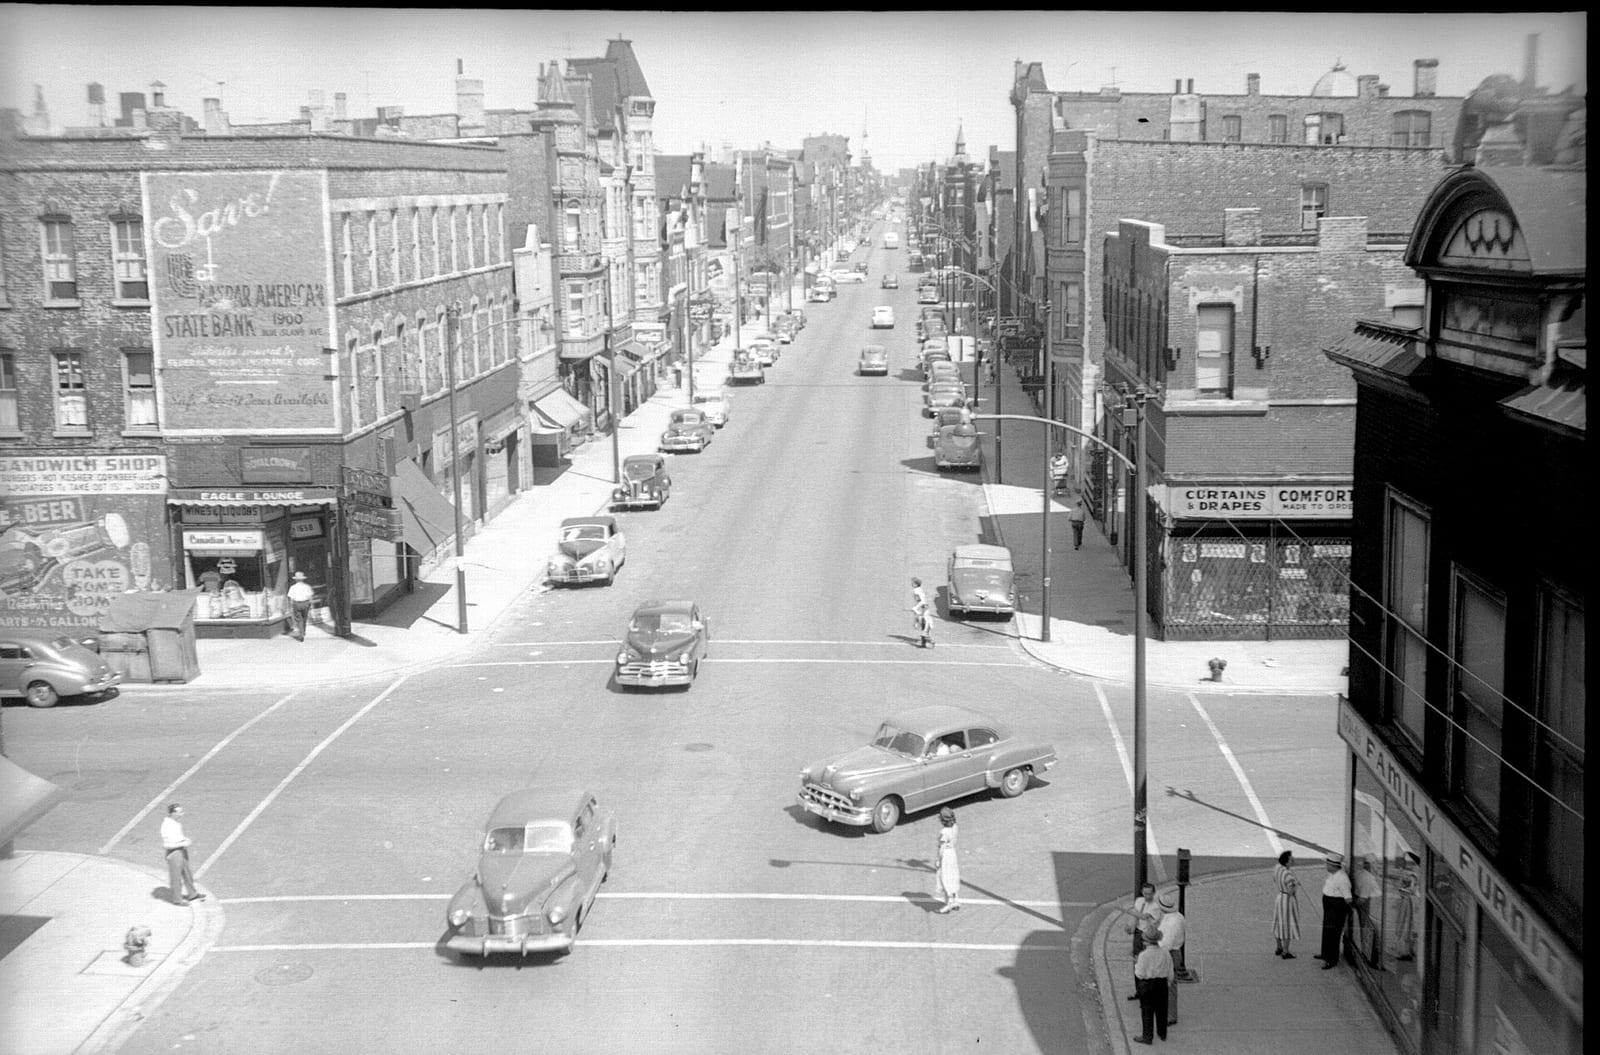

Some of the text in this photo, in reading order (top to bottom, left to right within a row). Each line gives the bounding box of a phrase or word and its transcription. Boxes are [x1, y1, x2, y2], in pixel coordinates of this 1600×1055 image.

[256, 283, 325, 308] AMERICAN
[272, 312, 304, 325] 1900
[164, 313, 256, 338] STATE BANK
[0, 458, 159, 472] SANDWICH SHOP
[200, 491, 305, 500] EAGLE LOUNGE
[1185, 490, 1267, 500] CURTAINS
[24, 500, 77, 523] BEER
[222, 504, 258, 518] LIQUORS
[1199, 501, 1262, 511] DRAPES
[189, 535, 226, 545] Canadian
[71, 567, 121, 579] TAKE
[73, 581, 122, 593] SOME
